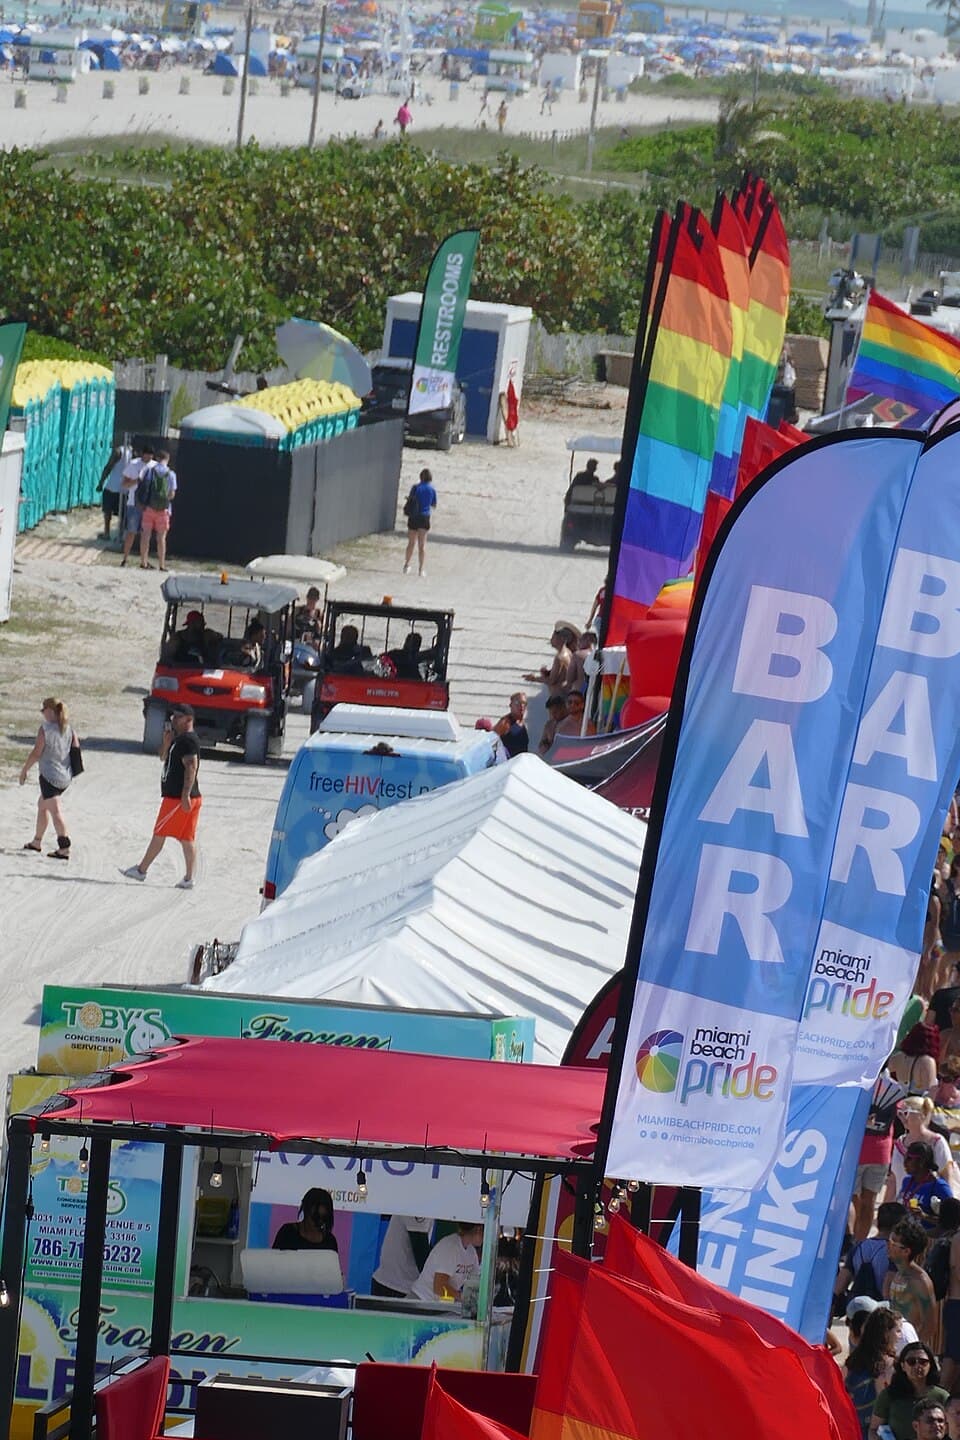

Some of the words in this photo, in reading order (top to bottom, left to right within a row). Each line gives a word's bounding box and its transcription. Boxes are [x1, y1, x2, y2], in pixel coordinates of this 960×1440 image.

[432, 252, 464, 366] RESTROOMS
[685, 584, 838, 964] BAR
[820, 949, 872, 971] miami
[814, 960, 866, 983] beach
[803, 977, 894, 1020] pride
[61, 1001, 170, 1050] TOBY'S
[695, 1026, 751, 1047] miami
[64, 1033, 122, 1045] CONCESSION
[71, 1043, 114, 1053] SERVICES
[690, 1040, 745, 1060] beach
[680, 1052, 778, 1105] pride
[637, 1113, 761, 1136] MIAMIBEACHPRIDE.COM
[39, 1226, 66, 1236] MIAMI
[110, 1232, 137, 1242] 33186
[58, 1216, 73, 1225] SW
[145, 1224, 151, 1233] 5
